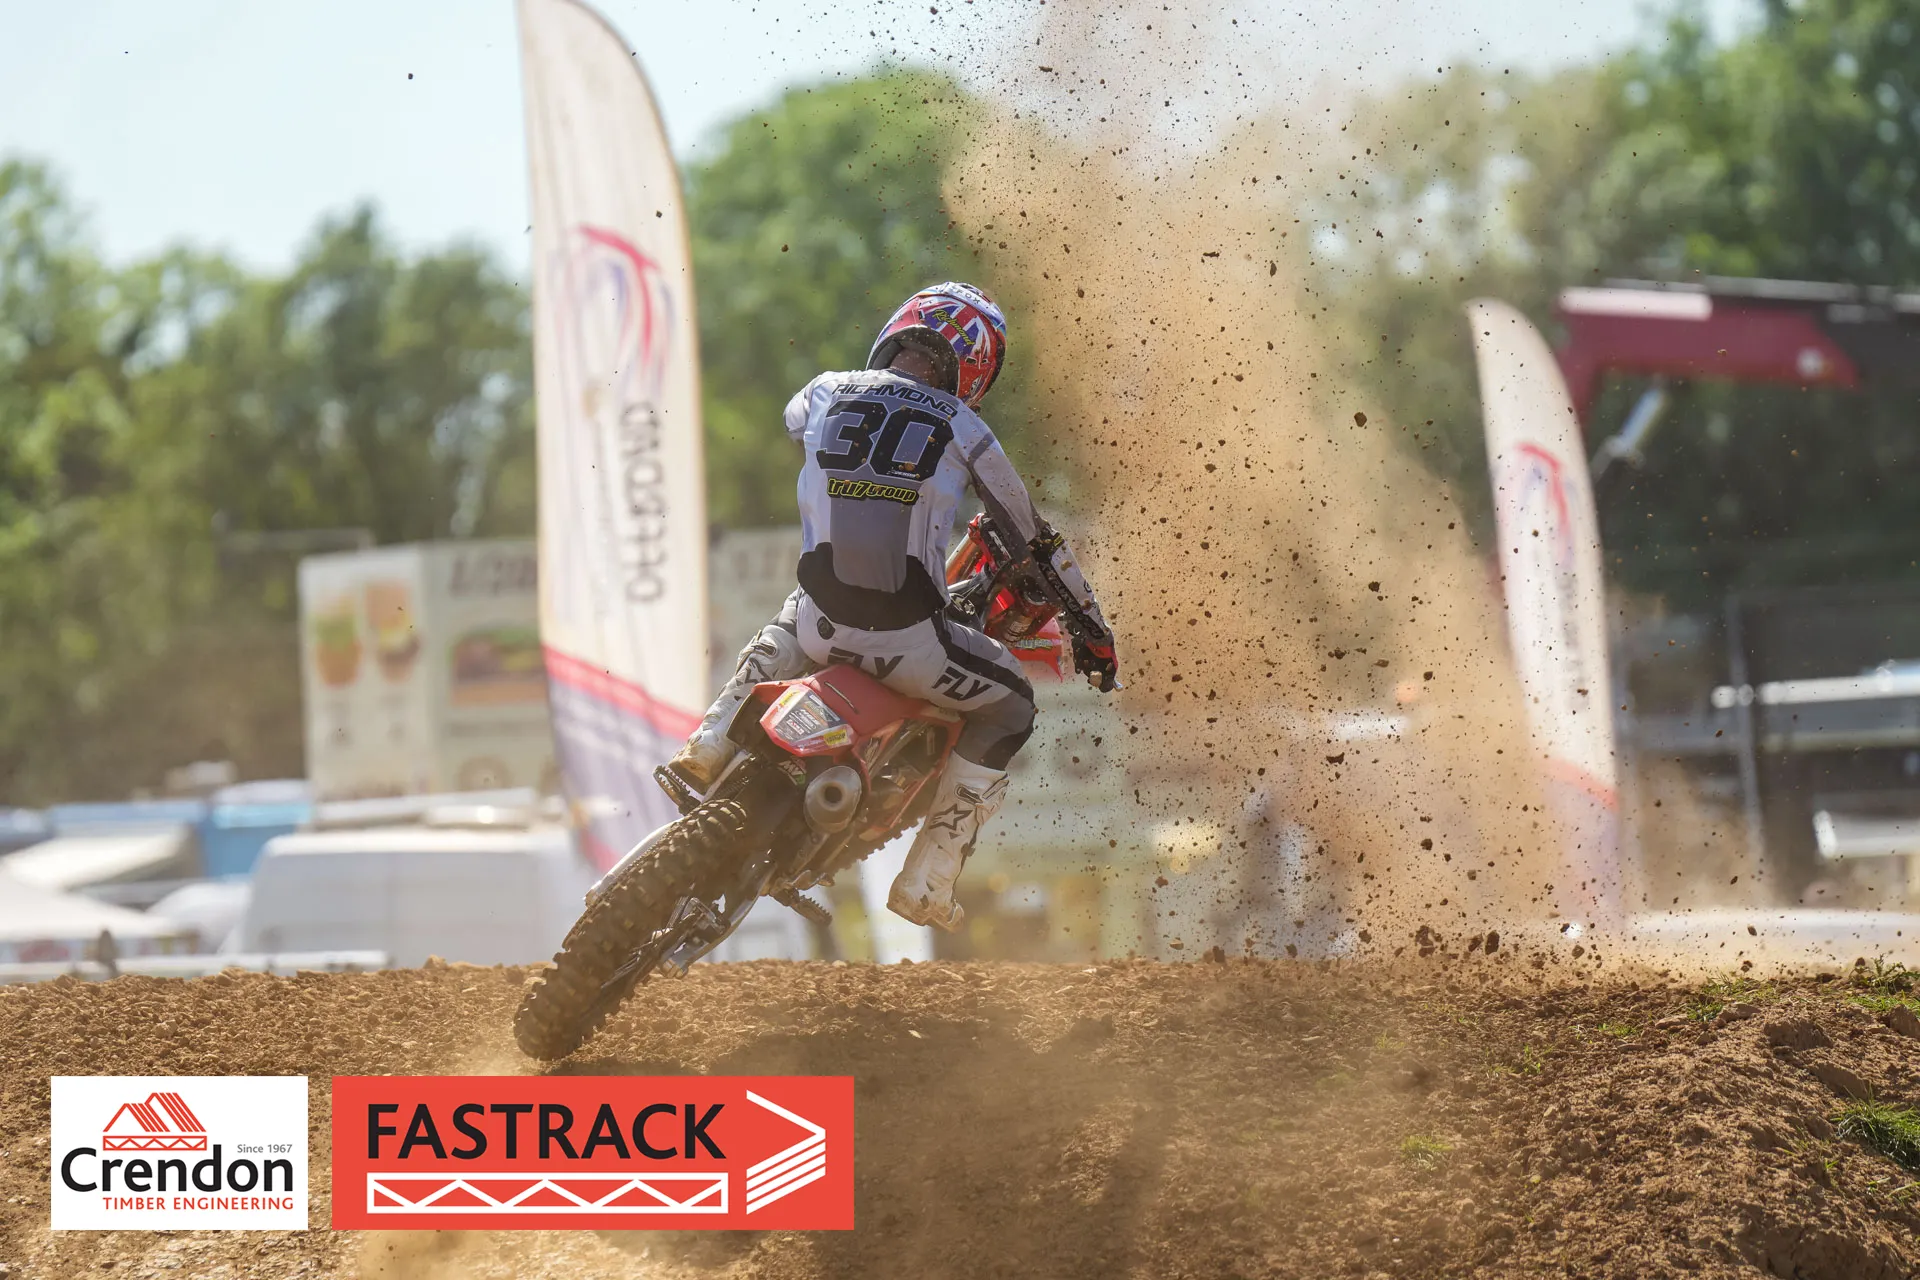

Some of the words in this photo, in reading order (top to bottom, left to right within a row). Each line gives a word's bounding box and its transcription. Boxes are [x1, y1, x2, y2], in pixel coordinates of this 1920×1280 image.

[931, 308, 975, 346] Richmond
[831, 383, 958, 418] RICHMOND
[815, 400, 954, 482] 30
[827, 477, 919, 504] tru7group
[931, 666, 993, 701] FLY
